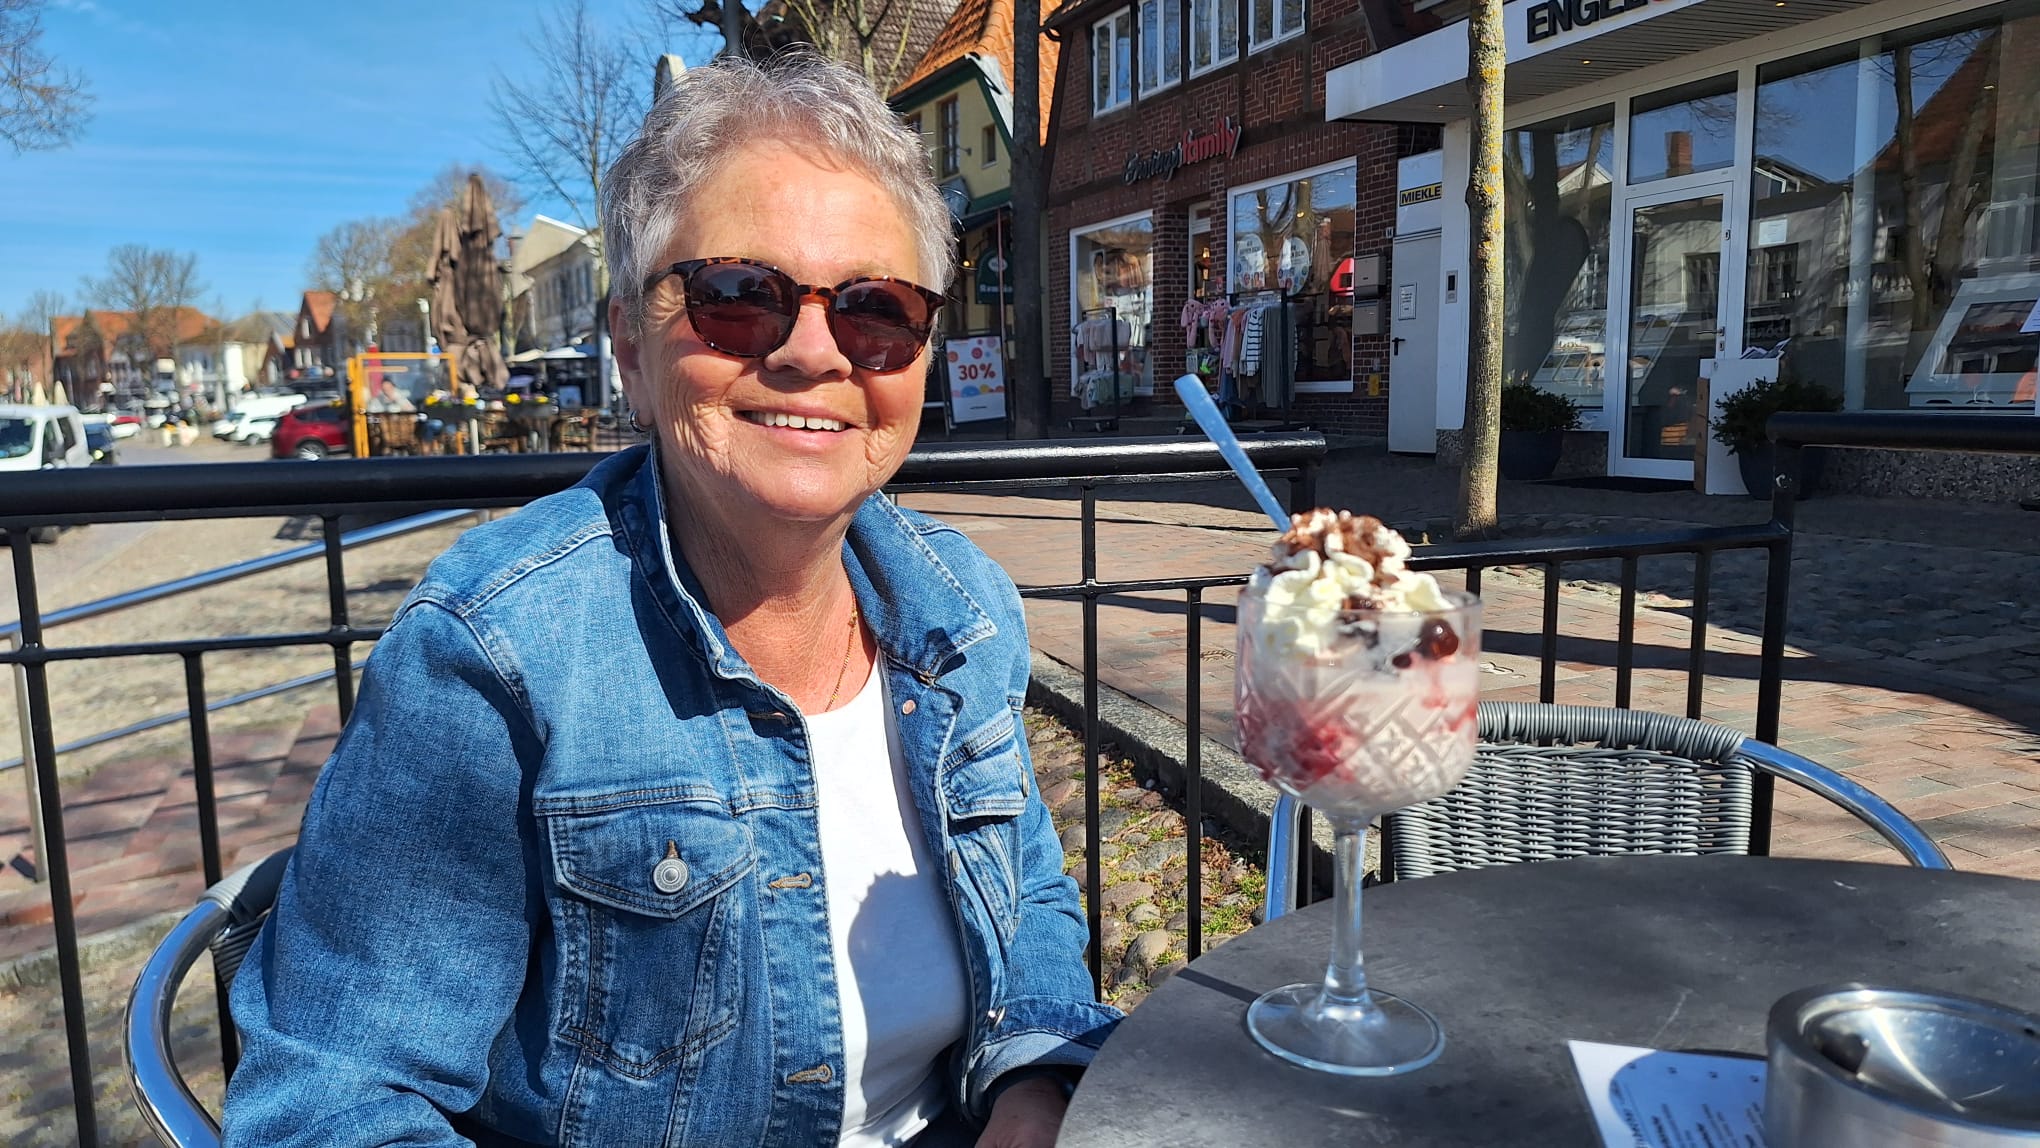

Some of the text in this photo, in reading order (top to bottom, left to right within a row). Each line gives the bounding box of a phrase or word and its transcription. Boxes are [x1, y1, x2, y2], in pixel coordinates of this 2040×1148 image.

[1527, 0, 1648, 44] ENG
[1182, 117, 1242, 162] family
[958, 362, 996, 381] 30%
